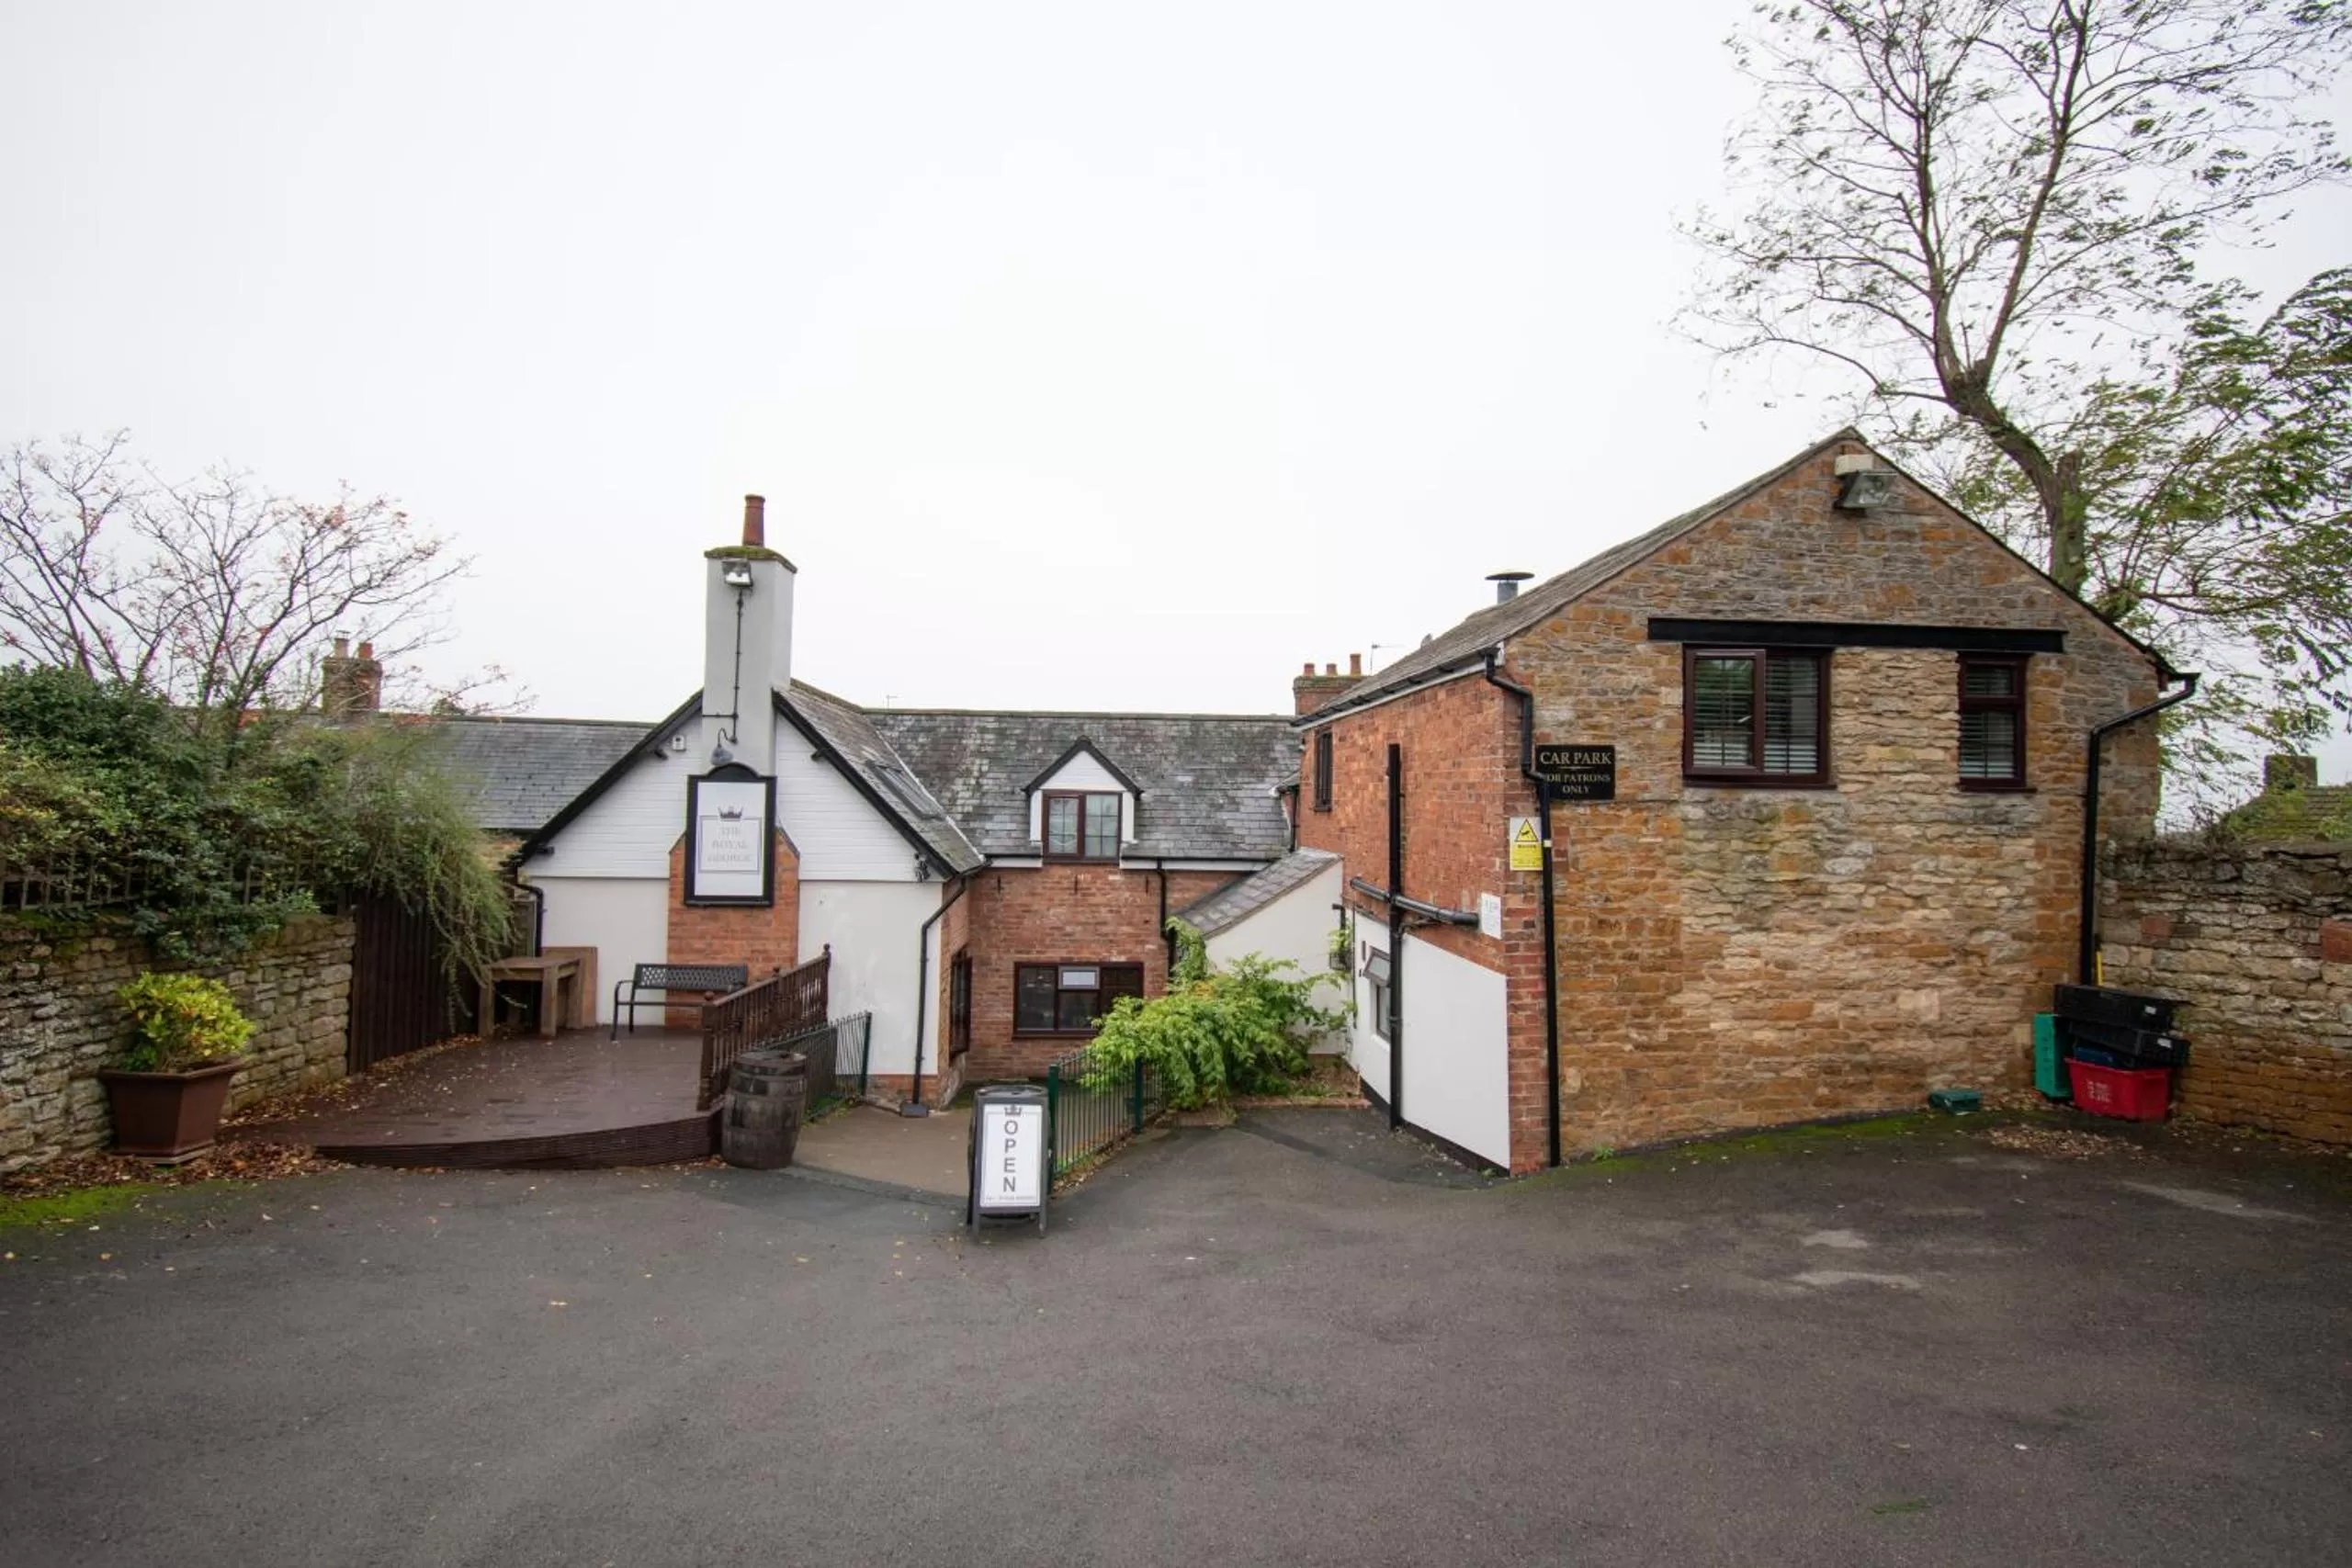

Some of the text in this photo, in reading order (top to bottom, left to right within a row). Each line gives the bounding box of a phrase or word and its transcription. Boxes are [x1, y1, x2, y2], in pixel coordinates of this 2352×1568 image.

[1540, 751, 1611, 764] CAR PARK
[1544, 773, 1611, 783] OR PATRONS
[1562, 784, 1589, 794] ONLY
[1003, 1120, 1019, 1192] OPEN
